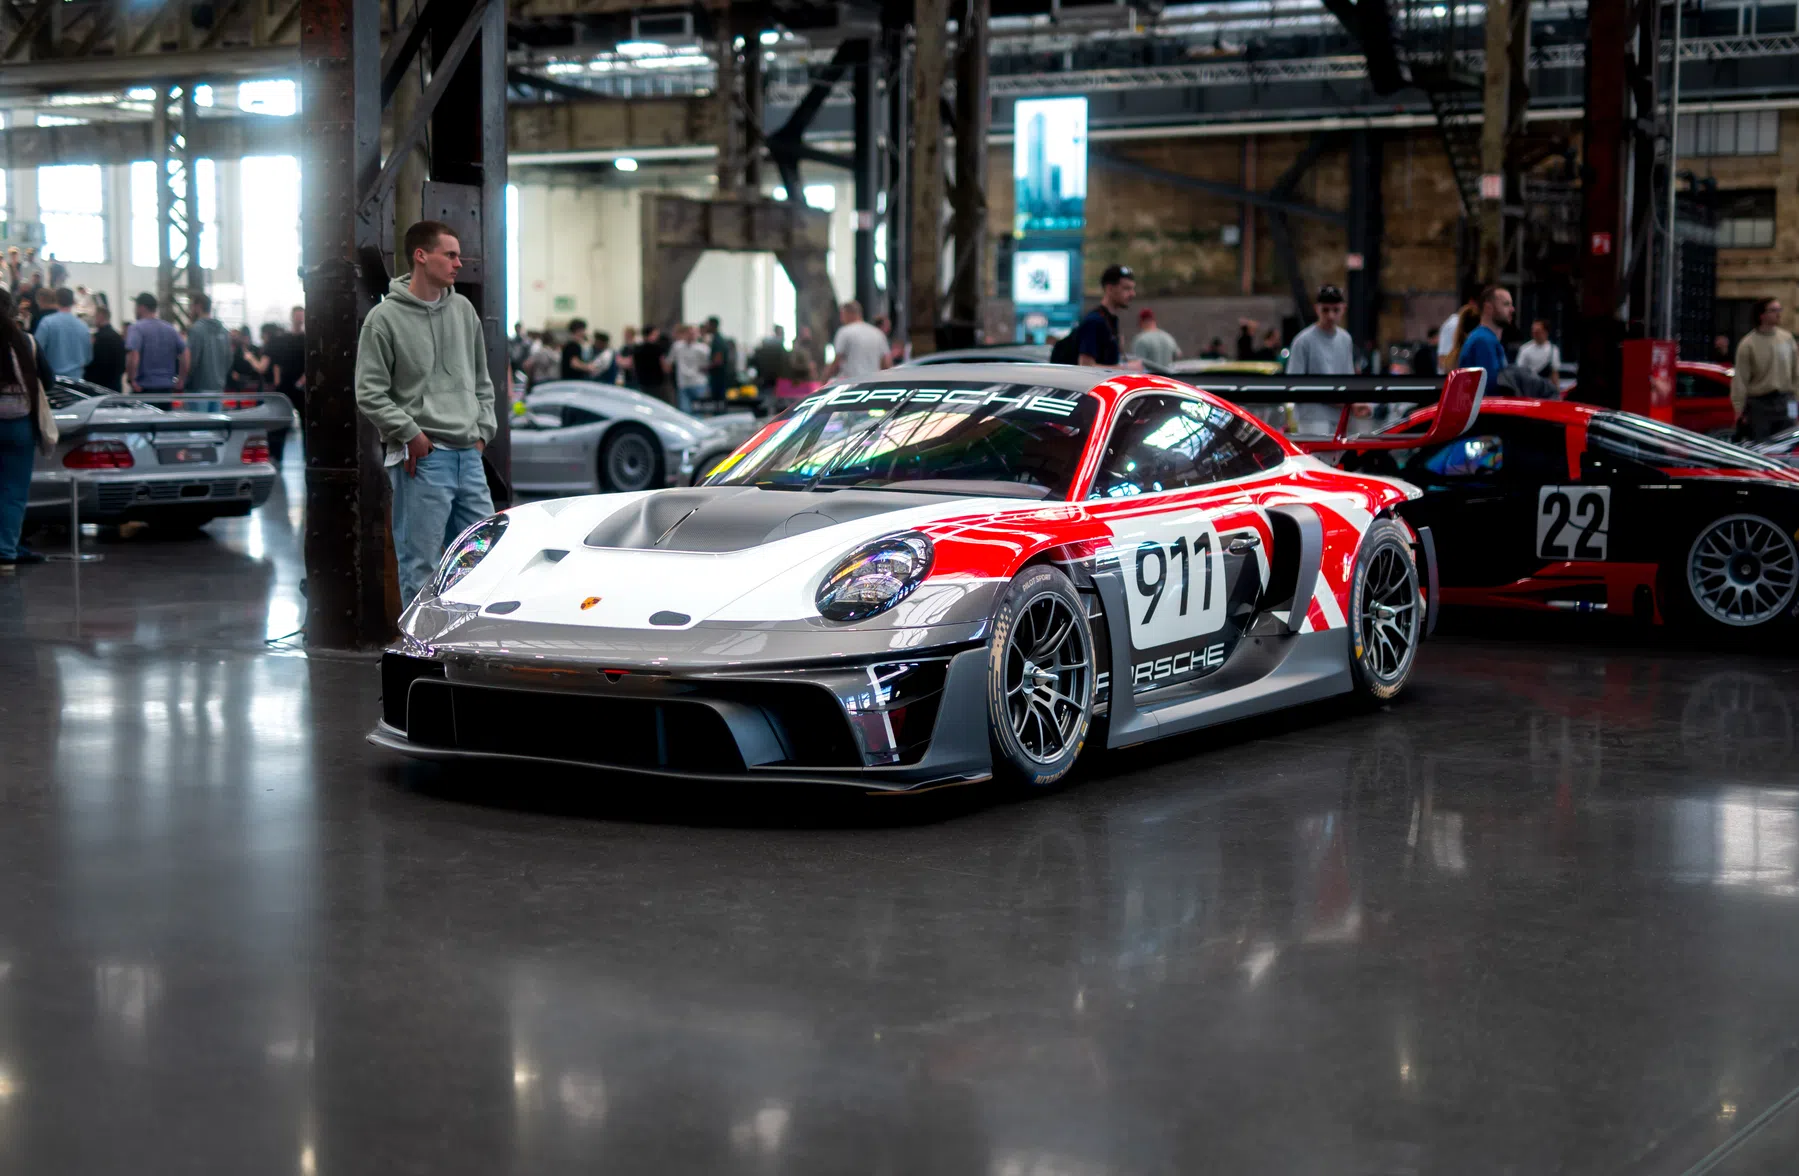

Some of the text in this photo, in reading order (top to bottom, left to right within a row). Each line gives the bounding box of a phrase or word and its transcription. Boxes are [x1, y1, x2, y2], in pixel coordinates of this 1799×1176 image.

[793, 388, 1079, 416] PORSCHE
[1541, 492, 1604, 558] 22
[1022, 574, 1051, 591] PILOT SPORT
[1136, 532, 1213, 625] 911
[1353, 569, 1363, 632] MICHELIN
[1095, 643, 1225, 694] PRSCHE
